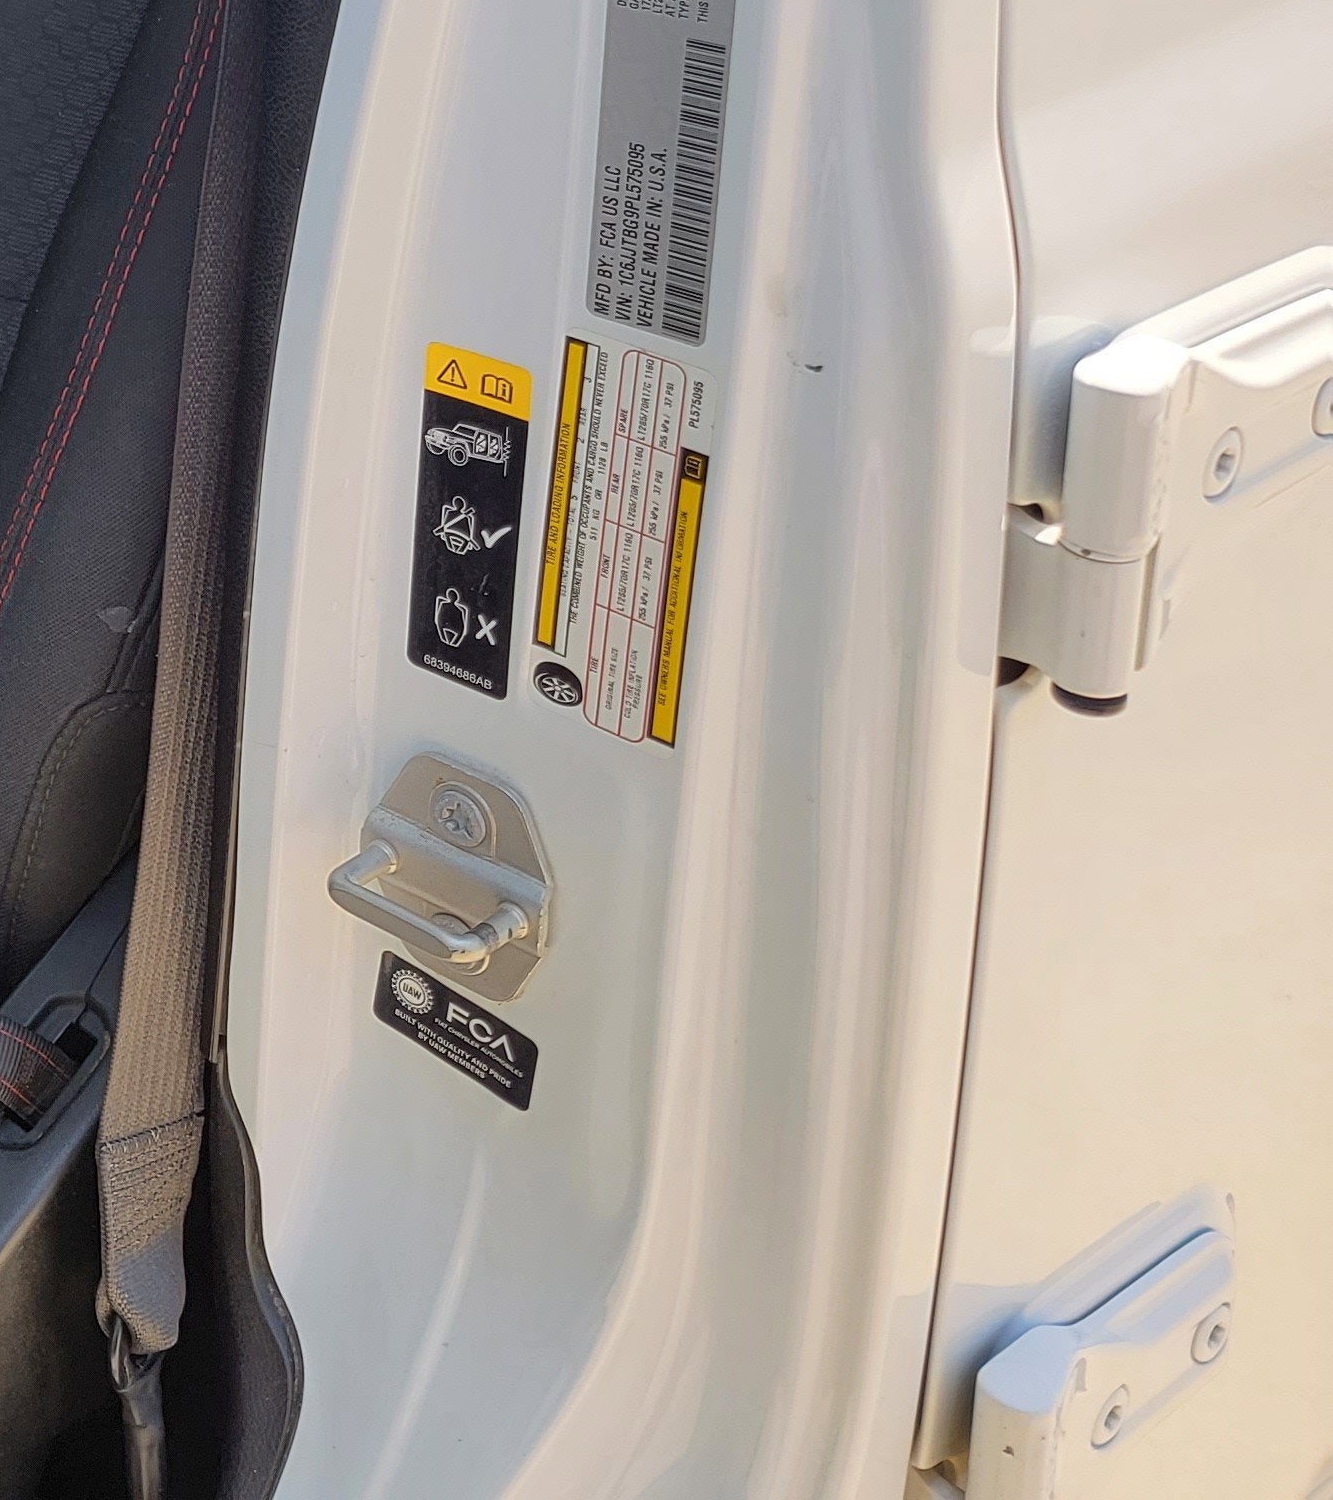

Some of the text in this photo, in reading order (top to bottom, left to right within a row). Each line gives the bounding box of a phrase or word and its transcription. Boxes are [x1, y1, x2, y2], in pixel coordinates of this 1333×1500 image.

[664, 3, 676, 17] AT
[697, 0, 709, 24] THIS
[594, 164, 621, 317] MFD BY: FCA US LLC
[615, 141, 645, 323] VIN: 1C6JJTBG9PL575095
[636, 145, 667, 330] VEHICLE MADE IN: U.S.A.
[688, 379, 705, 430] PL575095
[555, 421, 572, 484] INFORMATION
[550, 485, 564, 525] LOADING
[548, 523, 559, 545] AND
[402, 982, 422, 1000] UAW
[394, 1008, 512, 1089] BUILT WITH QUALITY AND PRIDE
[417, 1031, 486, 1079] BY UAW MEMBERS
